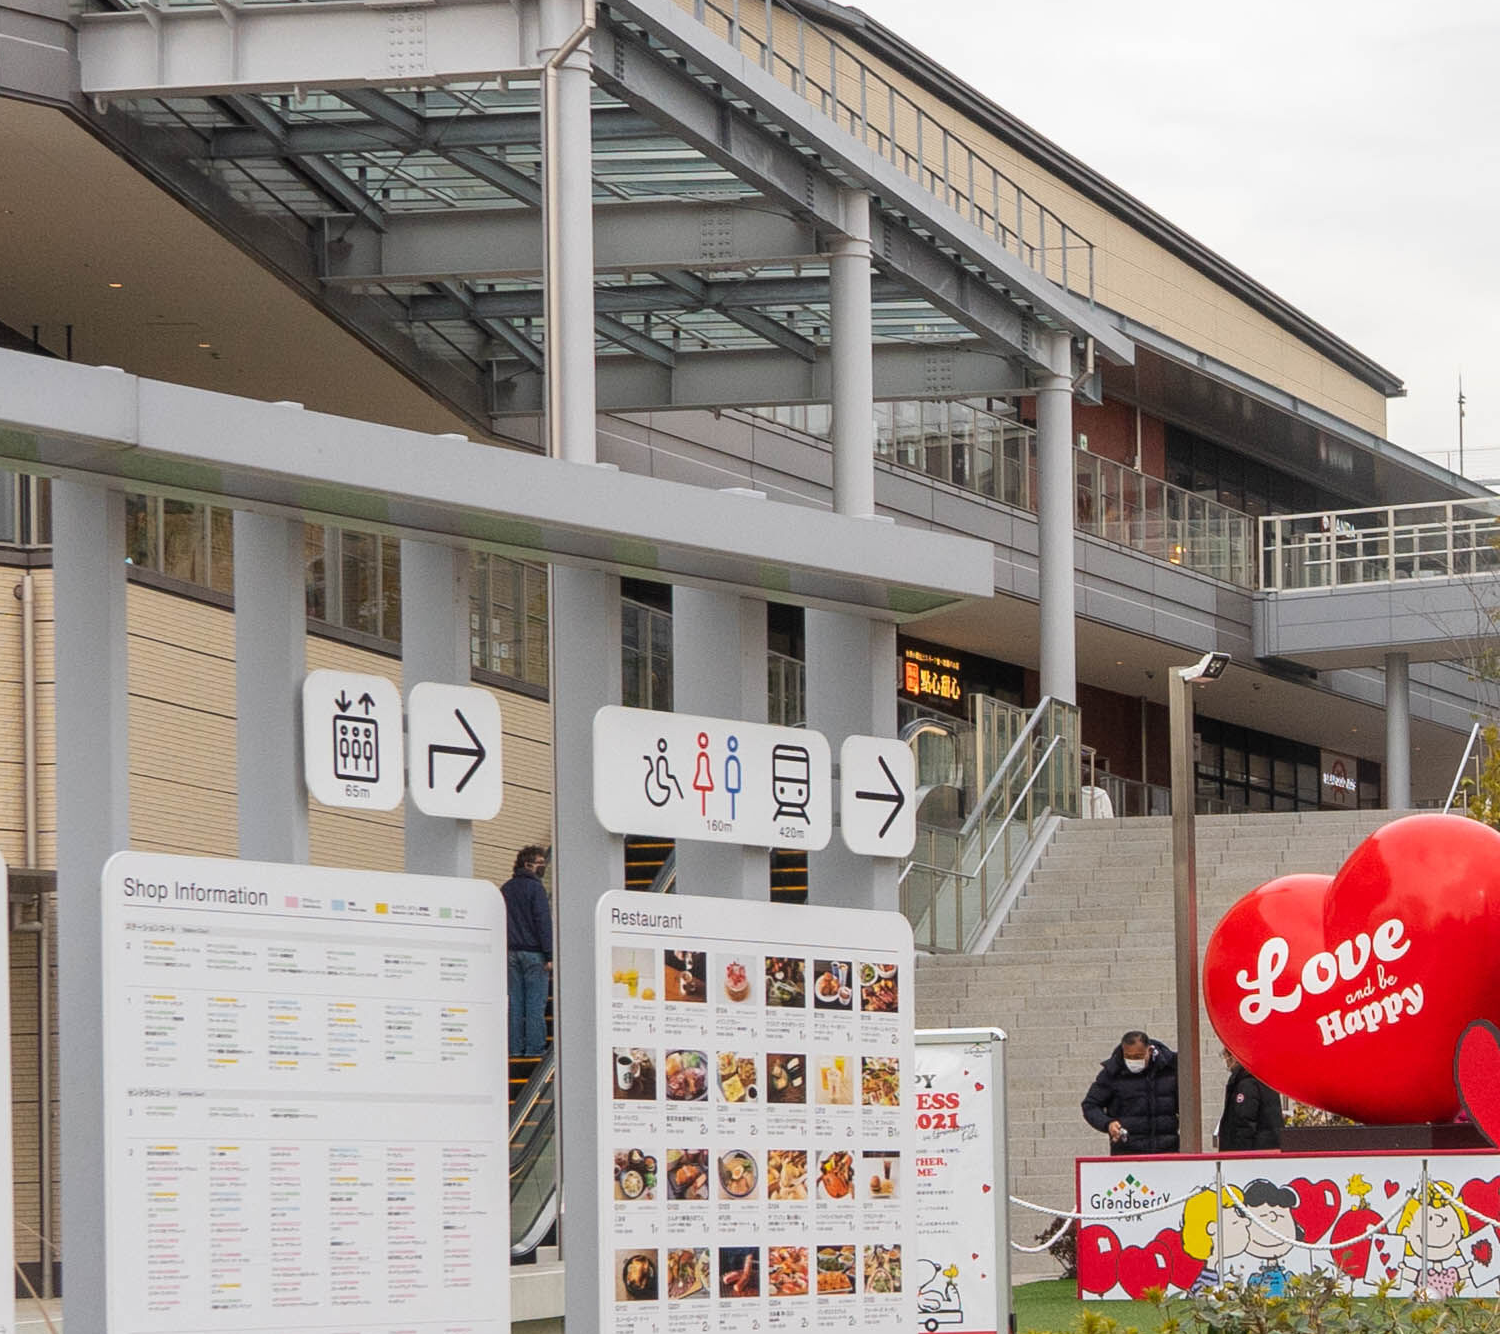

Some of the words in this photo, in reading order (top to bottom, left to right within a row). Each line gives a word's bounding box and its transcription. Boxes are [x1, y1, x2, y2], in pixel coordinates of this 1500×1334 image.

[345, 784, 370, 798] 65m
[706, 819, 733, 832] 160m
[779, 827, 805, 838] 420m
[123, 877, 169, 902] Shop
[174, 881, 269, 907] Information
[611, 907, 683, 929] Restaurant
[1236, 918, 1412, 1025] Love
[1345, 977, 1375, 1005] and
[1377, 964, 1398, 989] be
[1316, 983, 1425, 1046] Happy
[915, 1112, 960, 1130] 021
[1091, 1189, 1171, 1210] Grandberry
